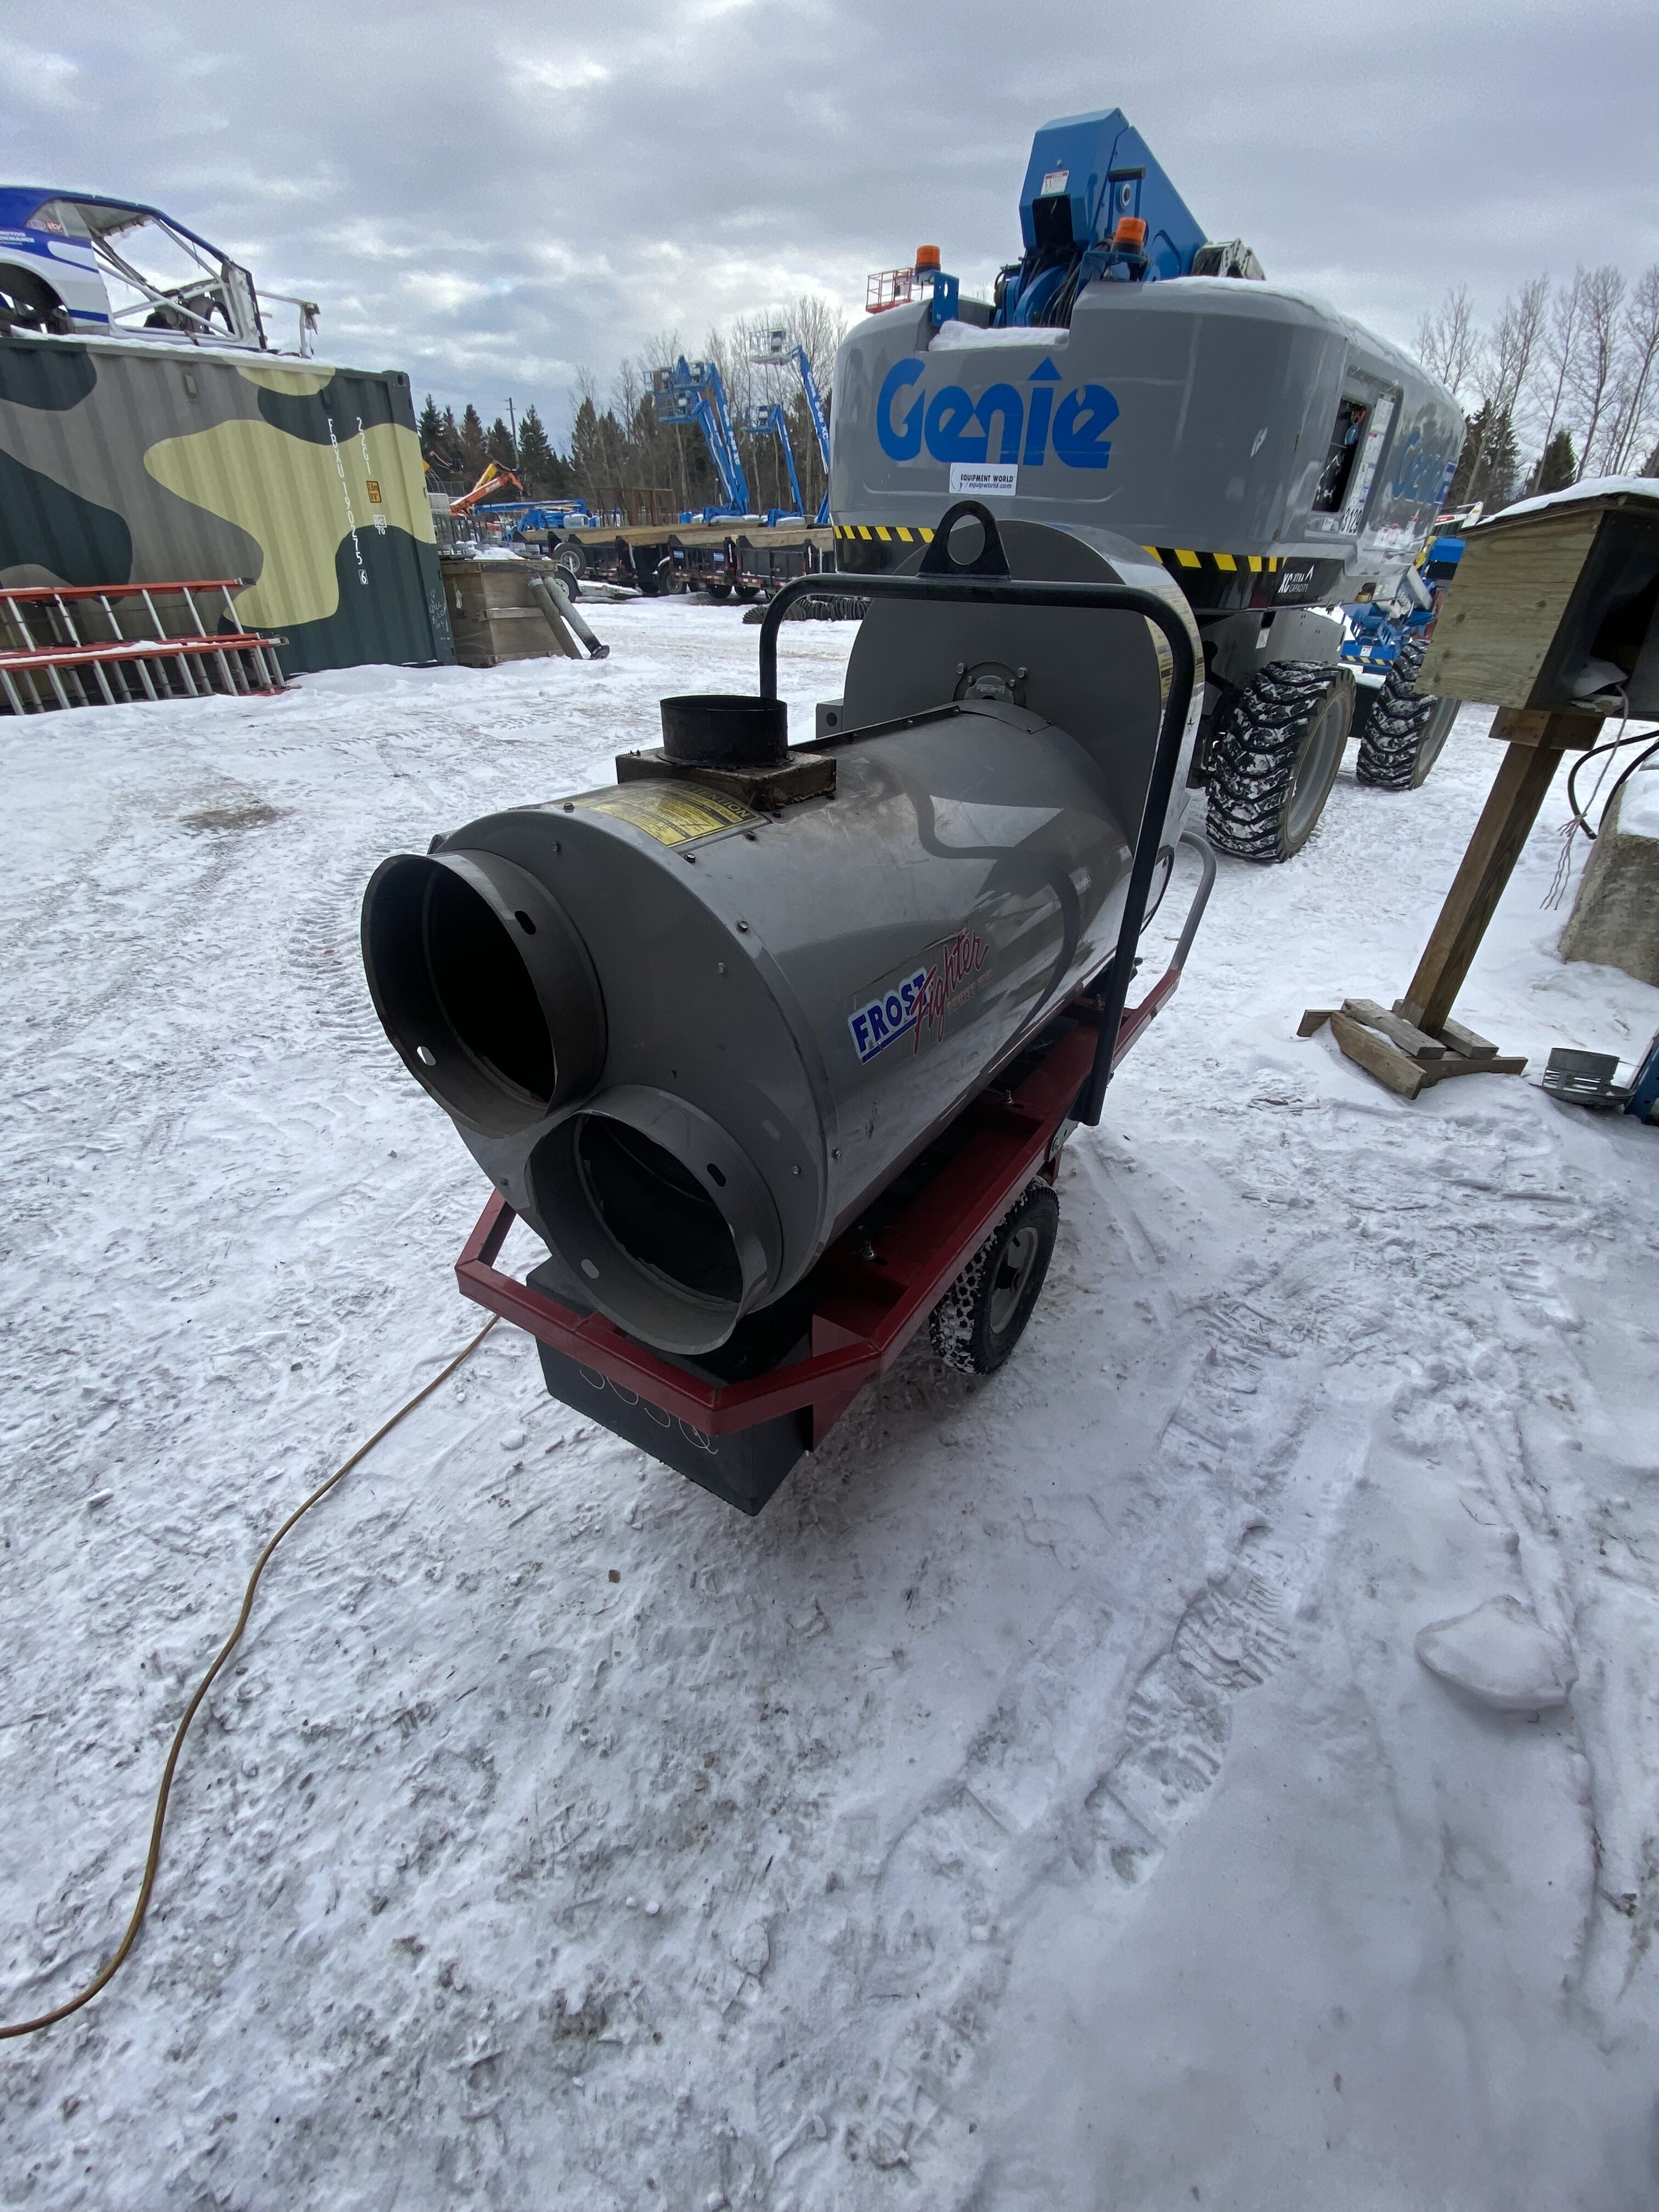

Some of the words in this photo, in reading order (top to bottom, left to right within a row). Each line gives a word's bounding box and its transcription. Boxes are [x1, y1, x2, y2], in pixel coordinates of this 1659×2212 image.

[356, 417, 371, 475] 22G1
[877, 356, 1120, 469] Genie
[328, 418, 345, 478] FBXU
[343, 482, 363, 565] 190275
[961, 474, 990, 482] EQUIPMENT
[1277, 573, 1294, 594] XC
[851, 972, 928, 1054] FROST
[909, 928, 990, 1057] Fighter
